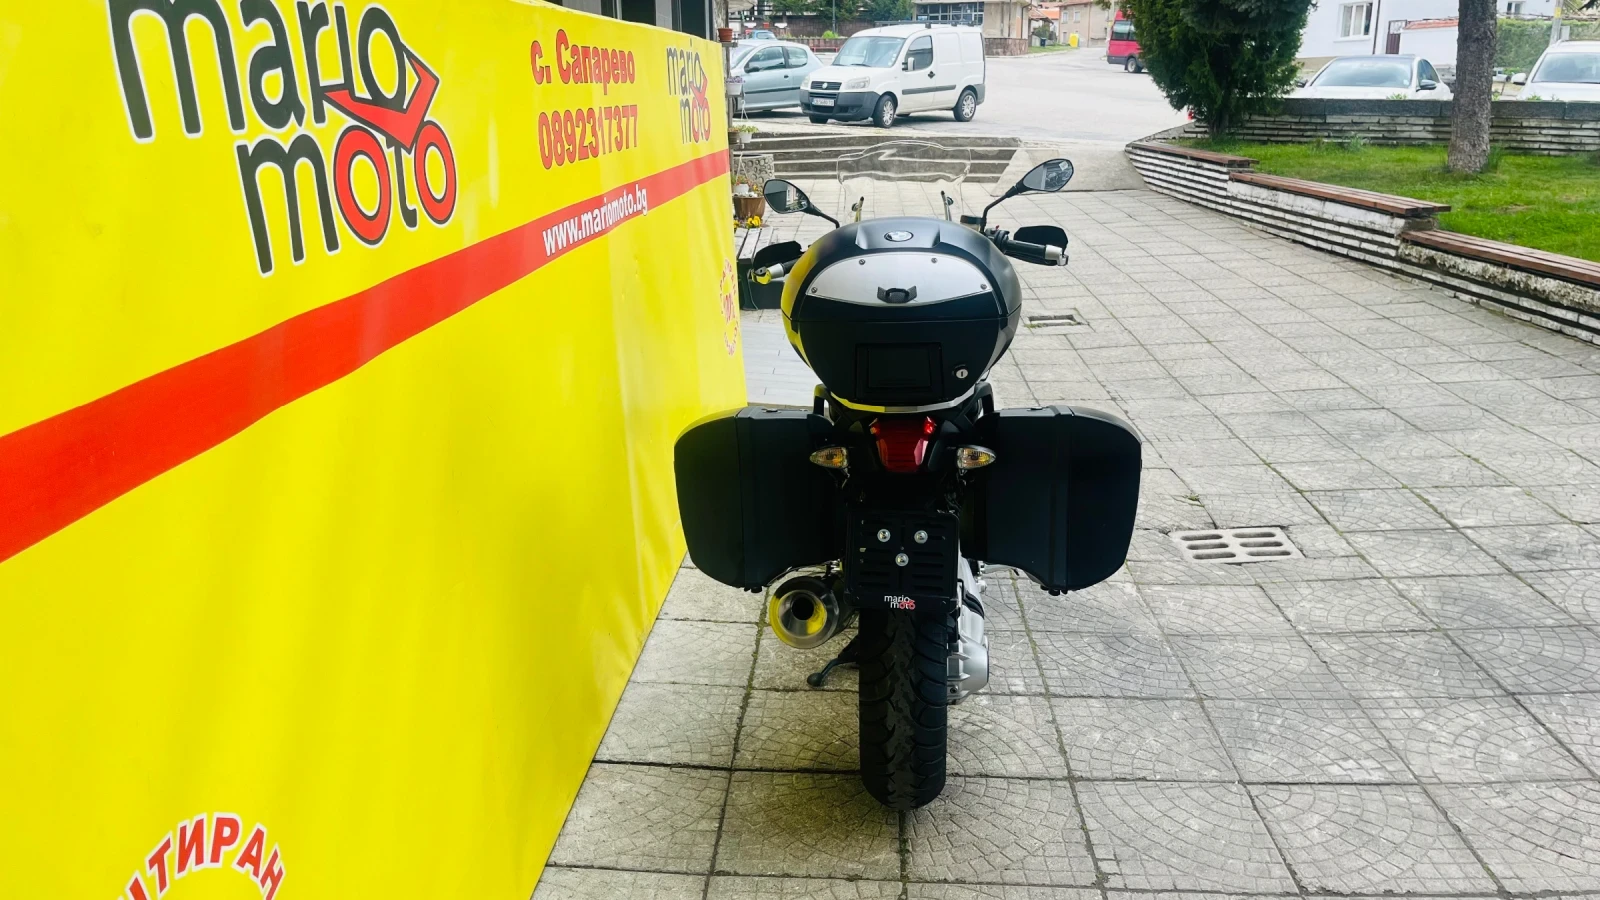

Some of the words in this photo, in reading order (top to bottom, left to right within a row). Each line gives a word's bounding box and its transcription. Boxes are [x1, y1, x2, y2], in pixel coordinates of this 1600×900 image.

[108, 0, 403, 139] mario
[530, 40, 552, 85] с.
[555, 28, 636, 96] Сапарево
[666, 38, 706, 96] mario
[537, 104, 639, 170] 0892317377
[679, 96, 711, 145] moto
[235, 120, 457, 276] moto
[542, 183, 648, 257] www.mariomoto.bg
[884, 594, 911, 603] mario
[890, 601, 916, 610] moto
